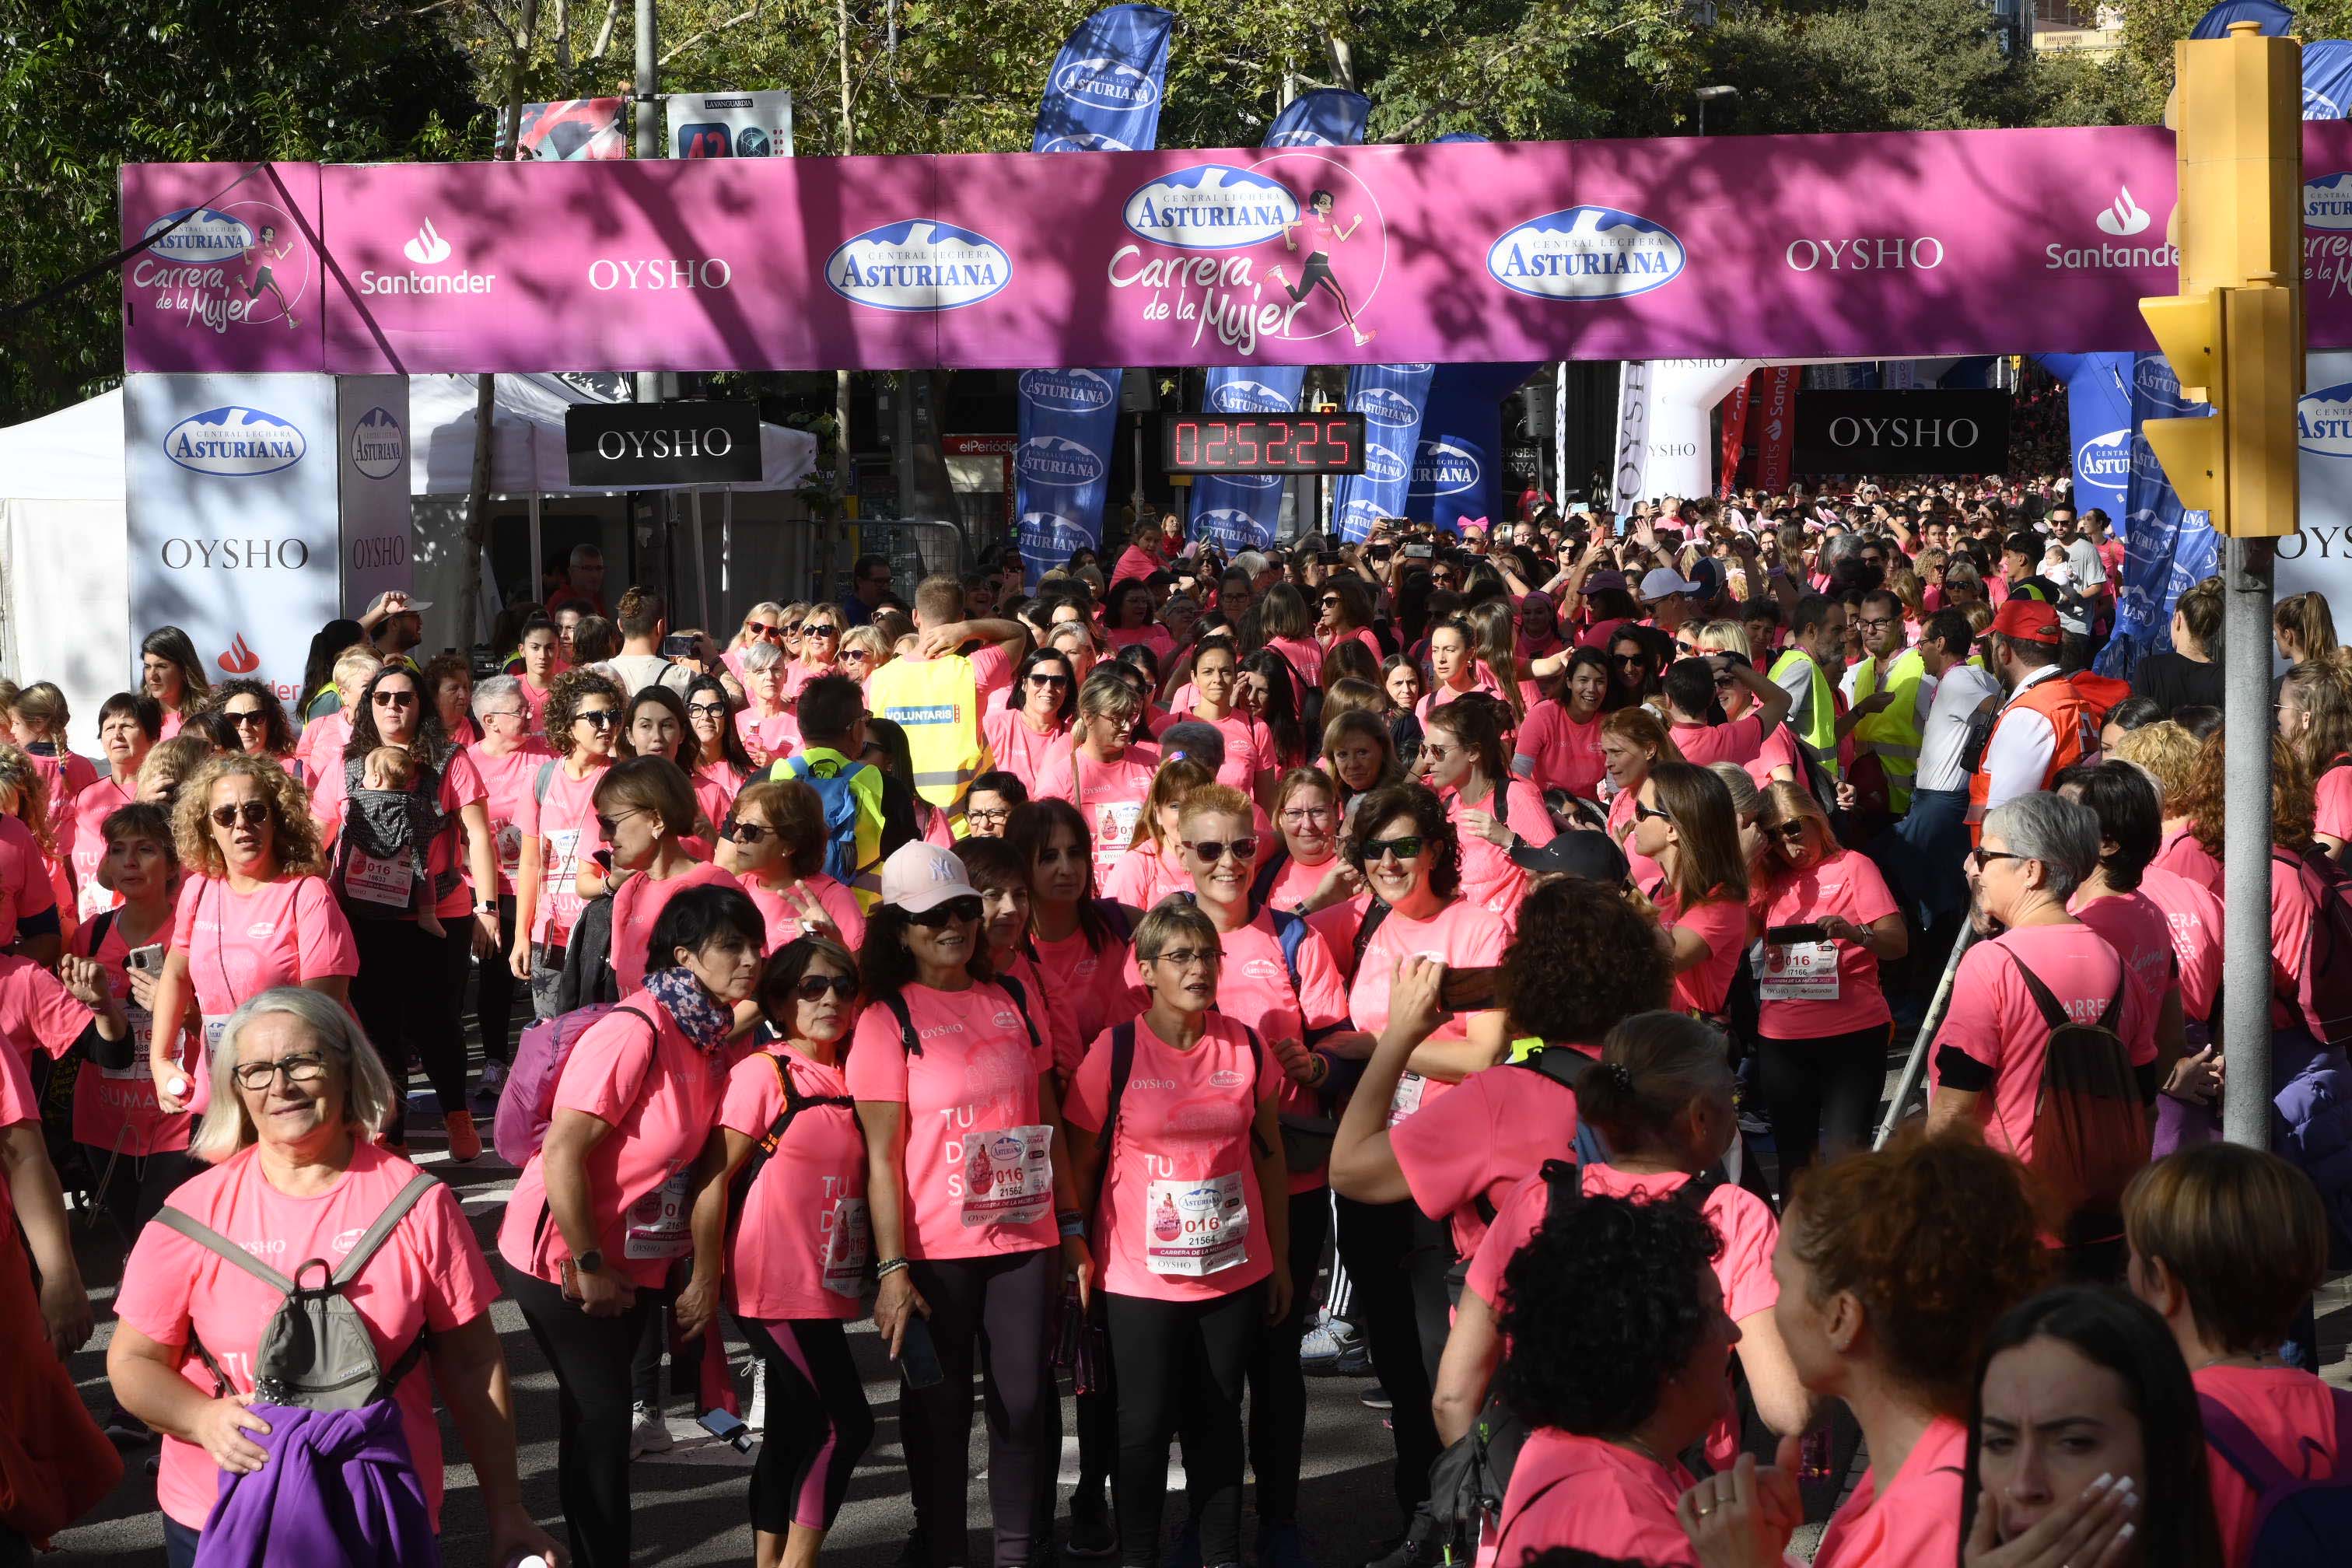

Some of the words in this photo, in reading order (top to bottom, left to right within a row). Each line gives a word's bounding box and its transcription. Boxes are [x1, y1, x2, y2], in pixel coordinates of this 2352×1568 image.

[1062, 71, 1149, 102] ASTURIANA
[1163, 194, 1220, 202] CENTRAL
[1225, 193, 1280, 201] LECHERA
[1136, 197, 1286, 228] ASTURIANA
[151, 227, 244, 250] ASTURIANA
[1532, 238, 1594, 249] CENTRAL
[1600, 237, 1664, 247] LECHERA
[868, 250, 927, 261] CENTRAL
[933, 250, 991, 260] LECHERA
[1502, 243, 1670, 277] ASTURIANA
[1786, 236, 1944, 271] OYSHO
[2046, 242, 2179, 269] Santande
[133, 259, 224, 288] Carrera
[588, 258, 731, 290] OYSHO
[838, 254, 997, 289] ASTURIANA
[1108, 245, 1253, 289] Carrera
[2318, 260, 2332, 280] la
[360, 270, 496, 296] Santander
[156, 290, 172, 310] de
[177, 289, 188, 310] la
[187, 285, 259, 334] Mujer
[1143, 289, 1170, 320] de
[1176, 289, 1195, 320] la
[1192, 282, 1307, 355] Mujer
[1026, 375, 1104, 404] ASTURIANA
[1356, 396, 1412, 424] ASTURIANA
[597, 427, 732, 460] OYSHO
[1176, 422, 1348, 465] 02:52:25
[1829, 416, 1979, 449] OYSHO
[175, 432, 297, 459] ASTURIANA
[355, 435, 401, 462] ASTURIANA
[1649, 443, 1696, 457] YSHO
[1410, 466, 1472, 483] URIANA
[161, 538, 309, 569] OYSHO
[353, 535, 405, 570] OYSHO
[1020, 533, 1086, 549] STURIANA
[886, 709, 953, 721] VOLUNTARIS
[78, 852, 98, 866] TU
[367, 863, 392, 875] 016
[929, 856, 956, 881] NY
[2167, 912, 2202, 929] ERA
[1785, 955, 1811, 966] 016
[135, 1029, 152, 1041] 16
[1132, 1078, 1176, 1090] OYSHO
[940, 1104, 975, 1131] TU
[996, 1167, 1024, 1184] 016
[1144, 1154, 1174, 1178] TU
[822, 1175, 849, 1199] TU
[1000, 1186, 1023, 1197] 21562
[1185, 1216, 1220, 1233] 016
[1188, 1235, 1216, 1245] 21564
[1157, 1261, 1192, 1269] OYSHO
